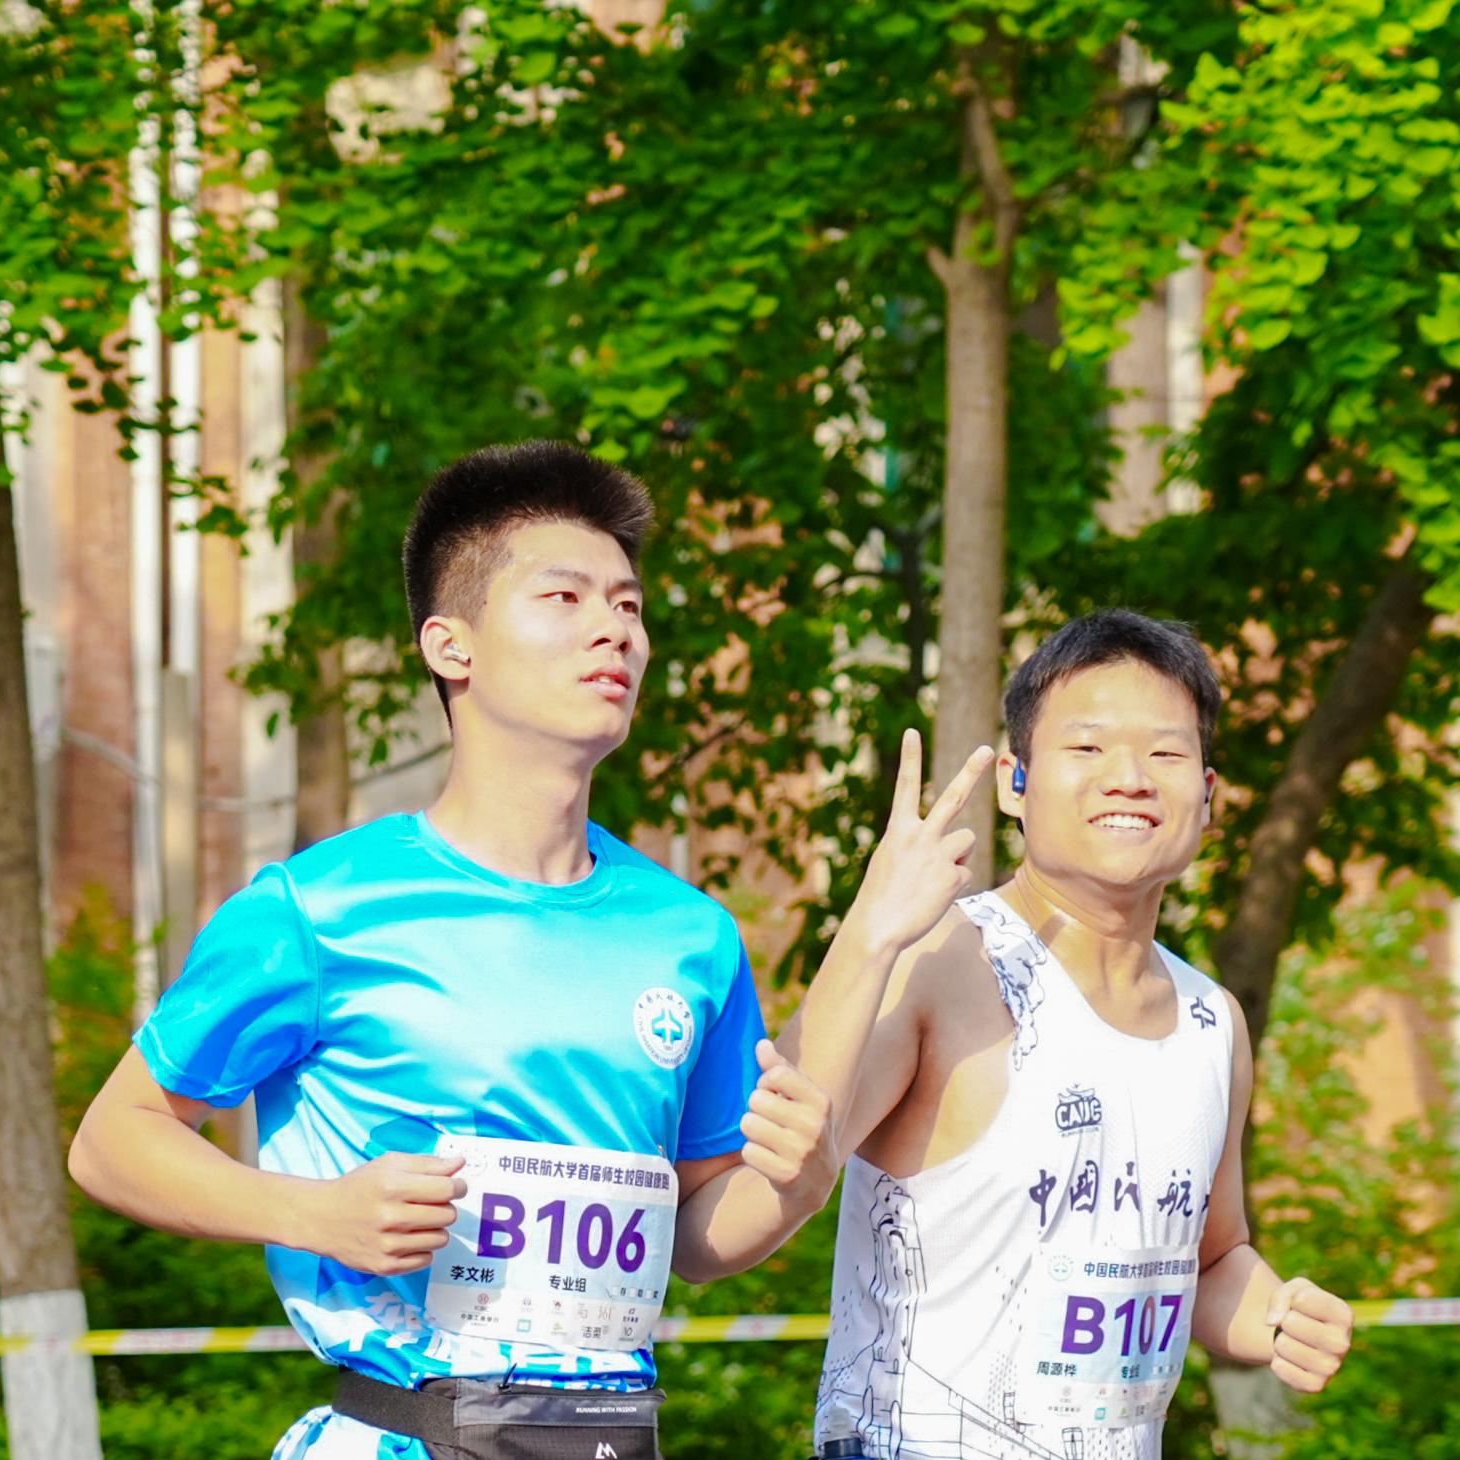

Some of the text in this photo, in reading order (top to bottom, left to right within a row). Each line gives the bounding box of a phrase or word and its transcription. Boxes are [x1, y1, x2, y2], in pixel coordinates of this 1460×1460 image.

[477, 1192, 646, 1273] B106
[450, 1265, 587, 1293] 李文彬 专业组
[1061, 1294, 1183, 1357] B107
